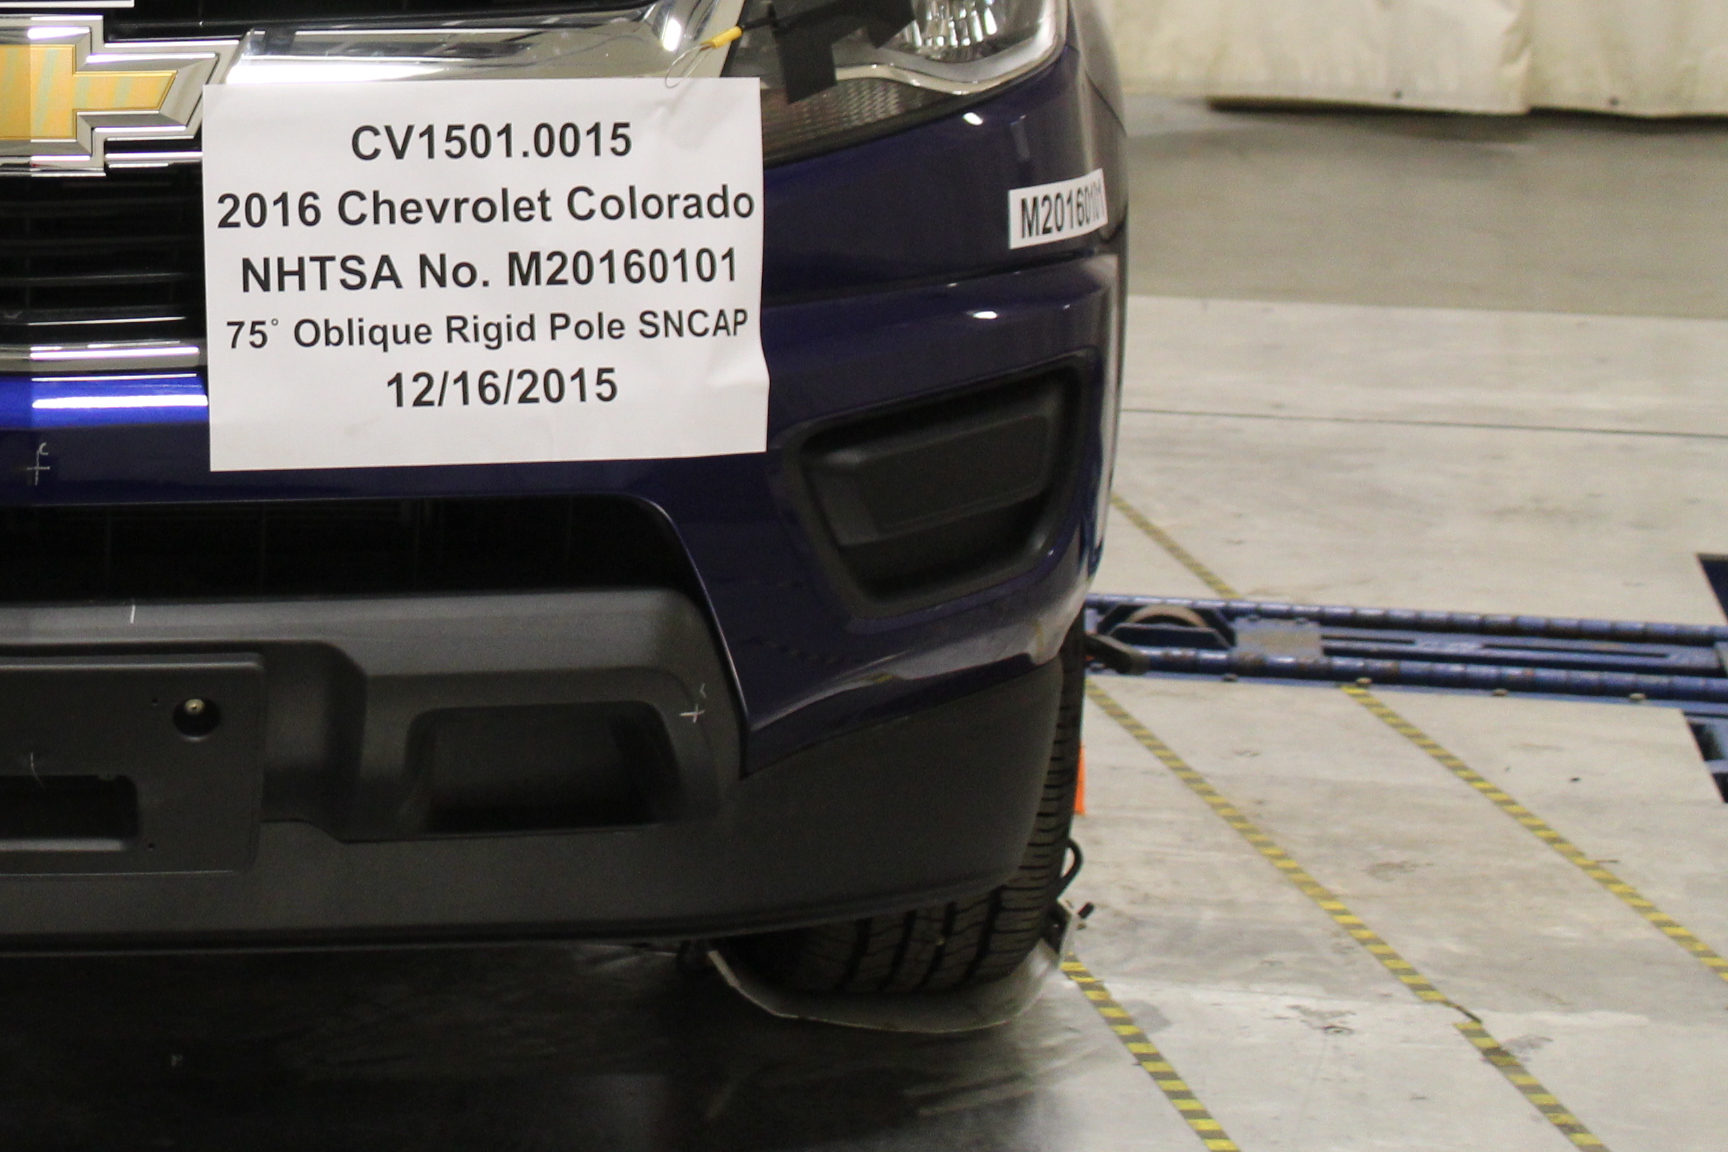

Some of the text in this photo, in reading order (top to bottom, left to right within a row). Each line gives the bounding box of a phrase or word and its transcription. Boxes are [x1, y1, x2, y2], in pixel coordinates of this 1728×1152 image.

[351, 121, 632, 161] CV1501.0015
[216, 183, 756, 229] 2016 Chevrolet Colorado
[241, 247, 737, 293] NHTSA No. M20160101
[225, 308, 749, 353] 75° Oblique Rigid Pole SNCAP
[386, 367, 618, 408] 12/16/2015
